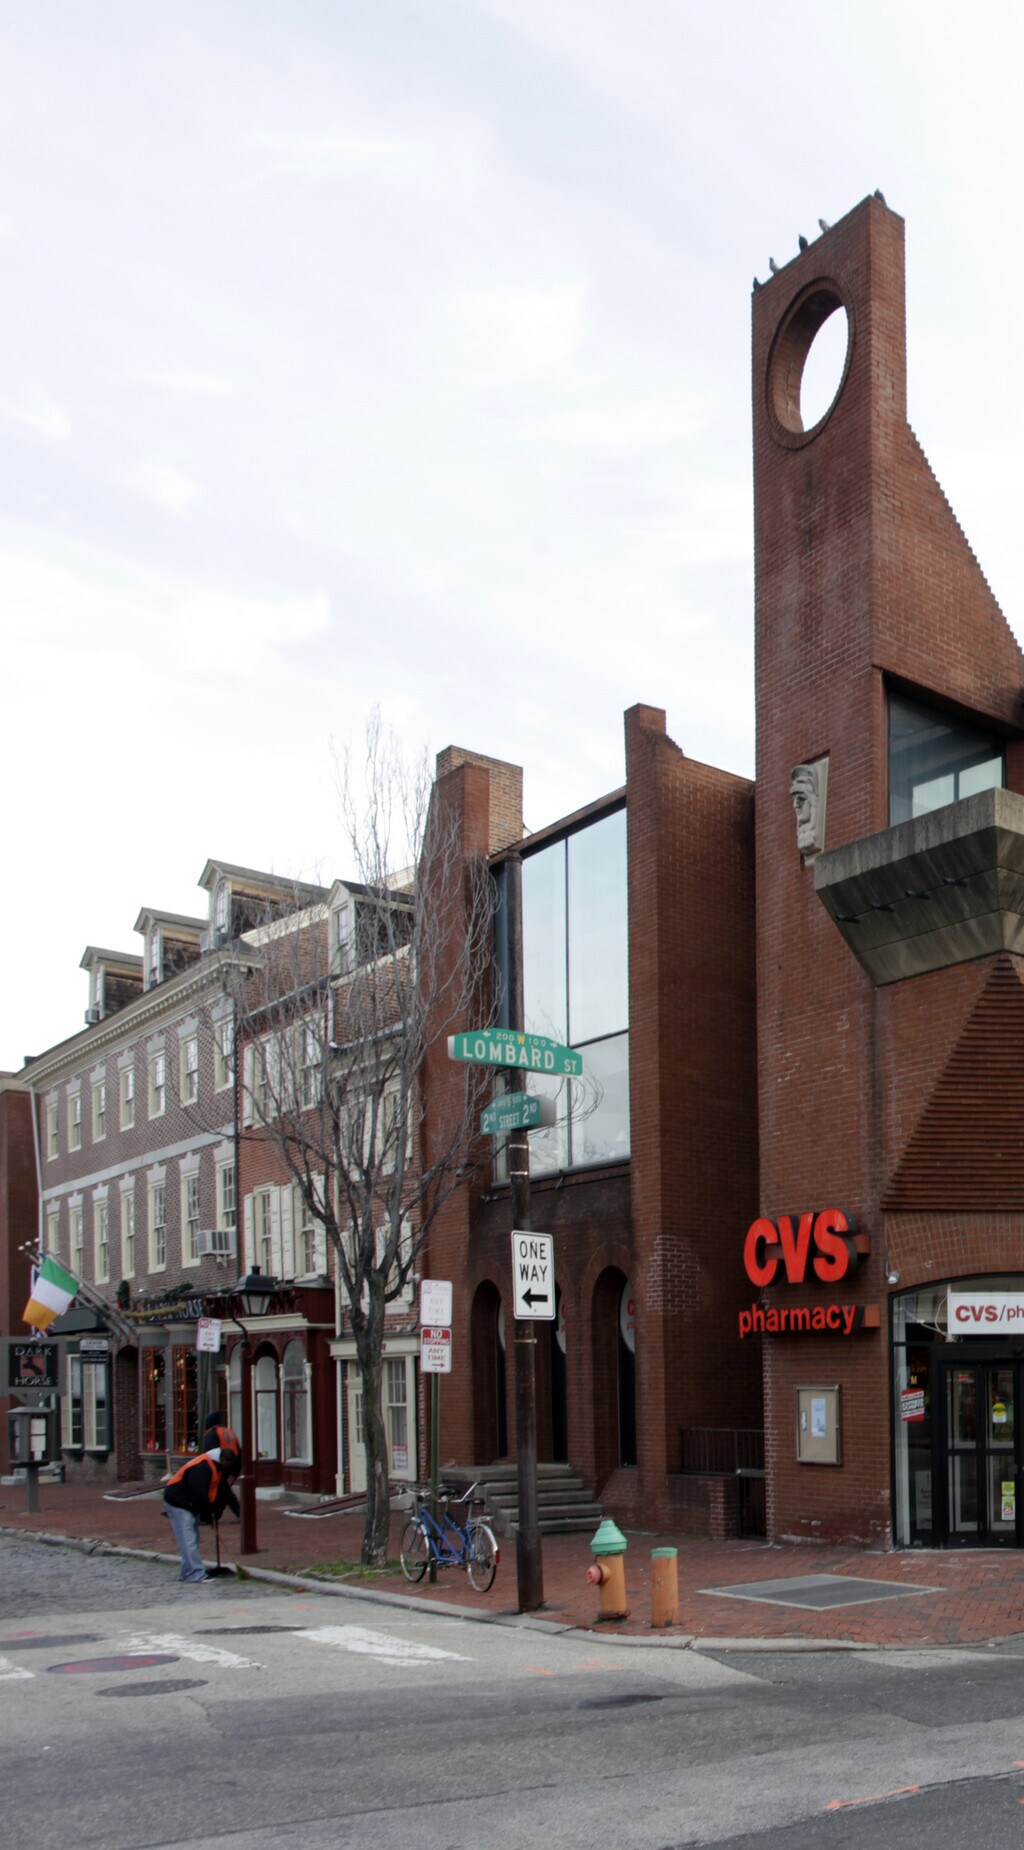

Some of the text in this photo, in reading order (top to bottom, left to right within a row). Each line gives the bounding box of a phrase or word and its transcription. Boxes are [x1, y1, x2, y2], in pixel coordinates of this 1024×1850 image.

[496, 1032, 547, 1047] 200 W 100
[463, 1037, 577, 1073] LOMBARD ST
[499, 1111, 520, 1129] STREET
[523, 1102, 537, 1124] 2ND
[519, 1240, 548, 1260] ONE
[744, 1208, 849, 1287] CVS
[519, 1264, 548, 1283] WAY
[738, 1303, 857, 1339] pharmacy
[423, 1337, 450, 1346] STOPPING
[430, 1329, 443, 1339] NO
[15, 1346, 52, 1357] DARK
[15, 1375, 52, 1387] HORSE
